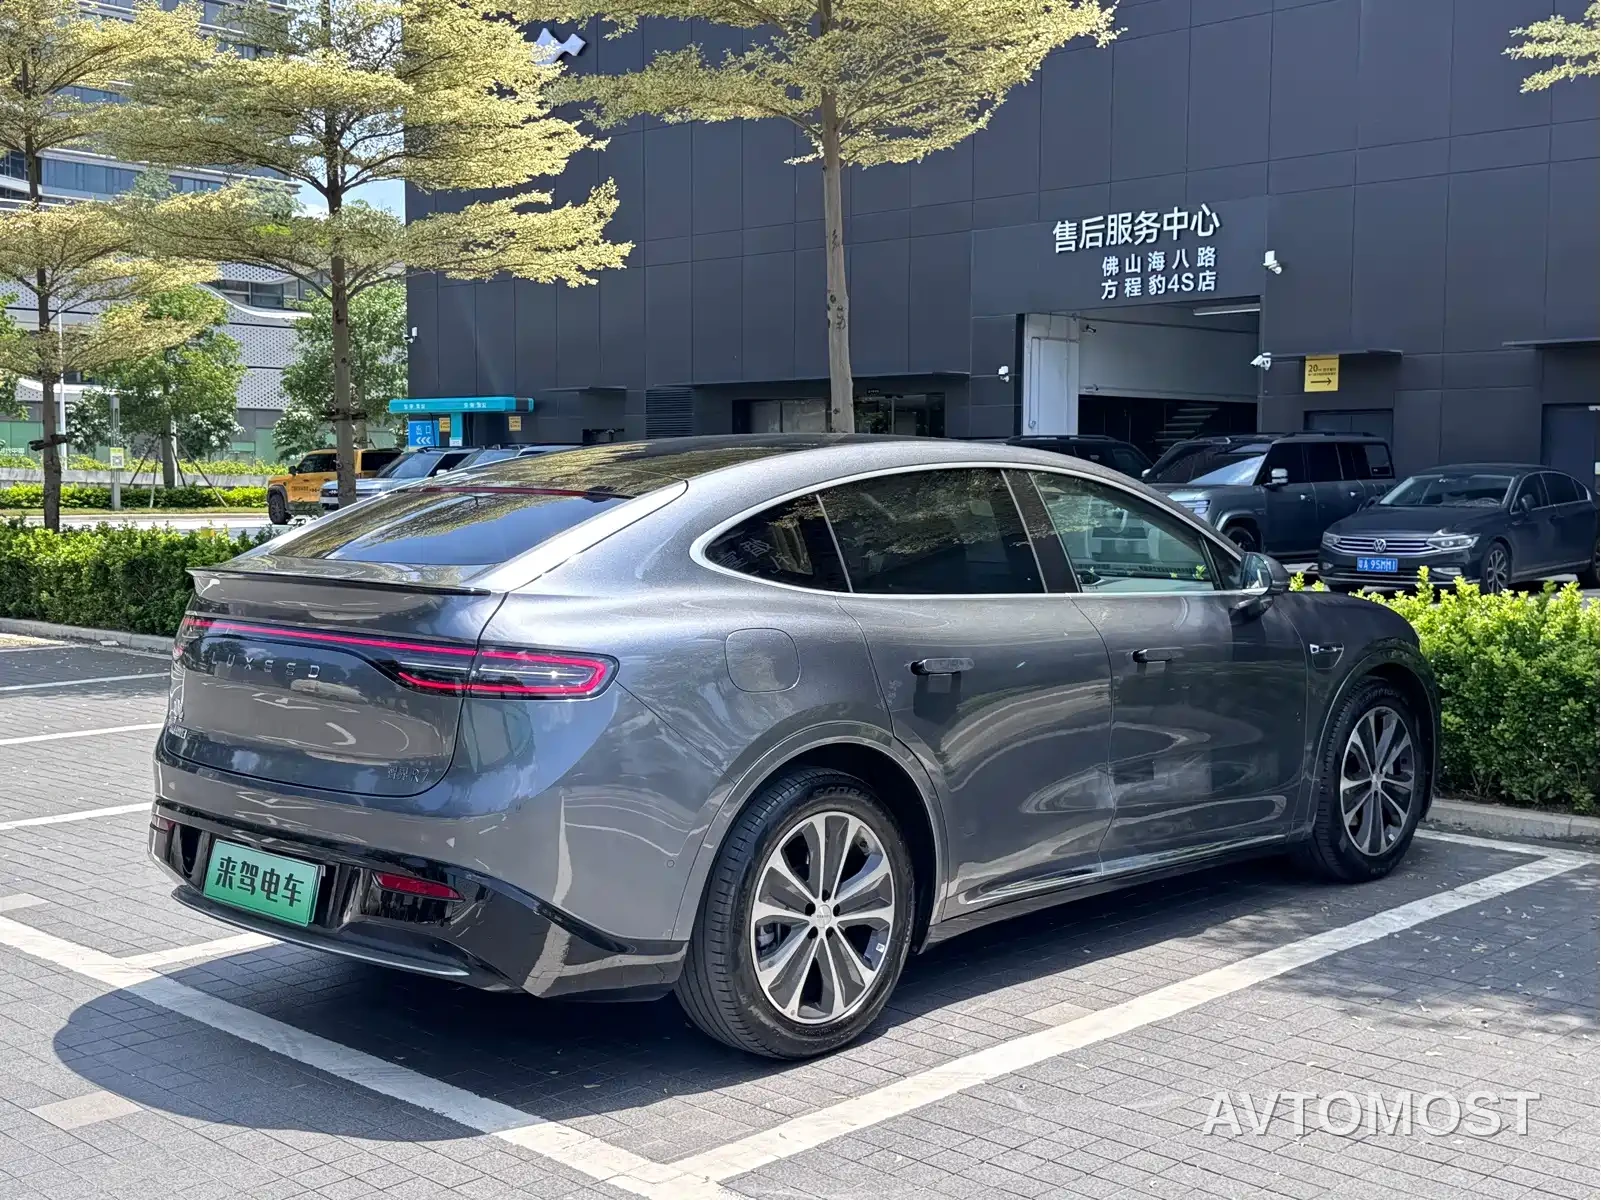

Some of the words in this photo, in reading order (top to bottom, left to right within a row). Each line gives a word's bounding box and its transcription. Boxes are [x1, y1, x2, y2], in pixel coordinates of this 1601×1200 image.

[1052, 203, 1220, 253] 售后服务中心
[1102, 246, 1216, 277] 佛山海八路
[1101, 270, 1217, 300] 方程豹4S店
[211, 651, 320, 678] LUXEED
[215, 855, 304, 907] 来驾电车
